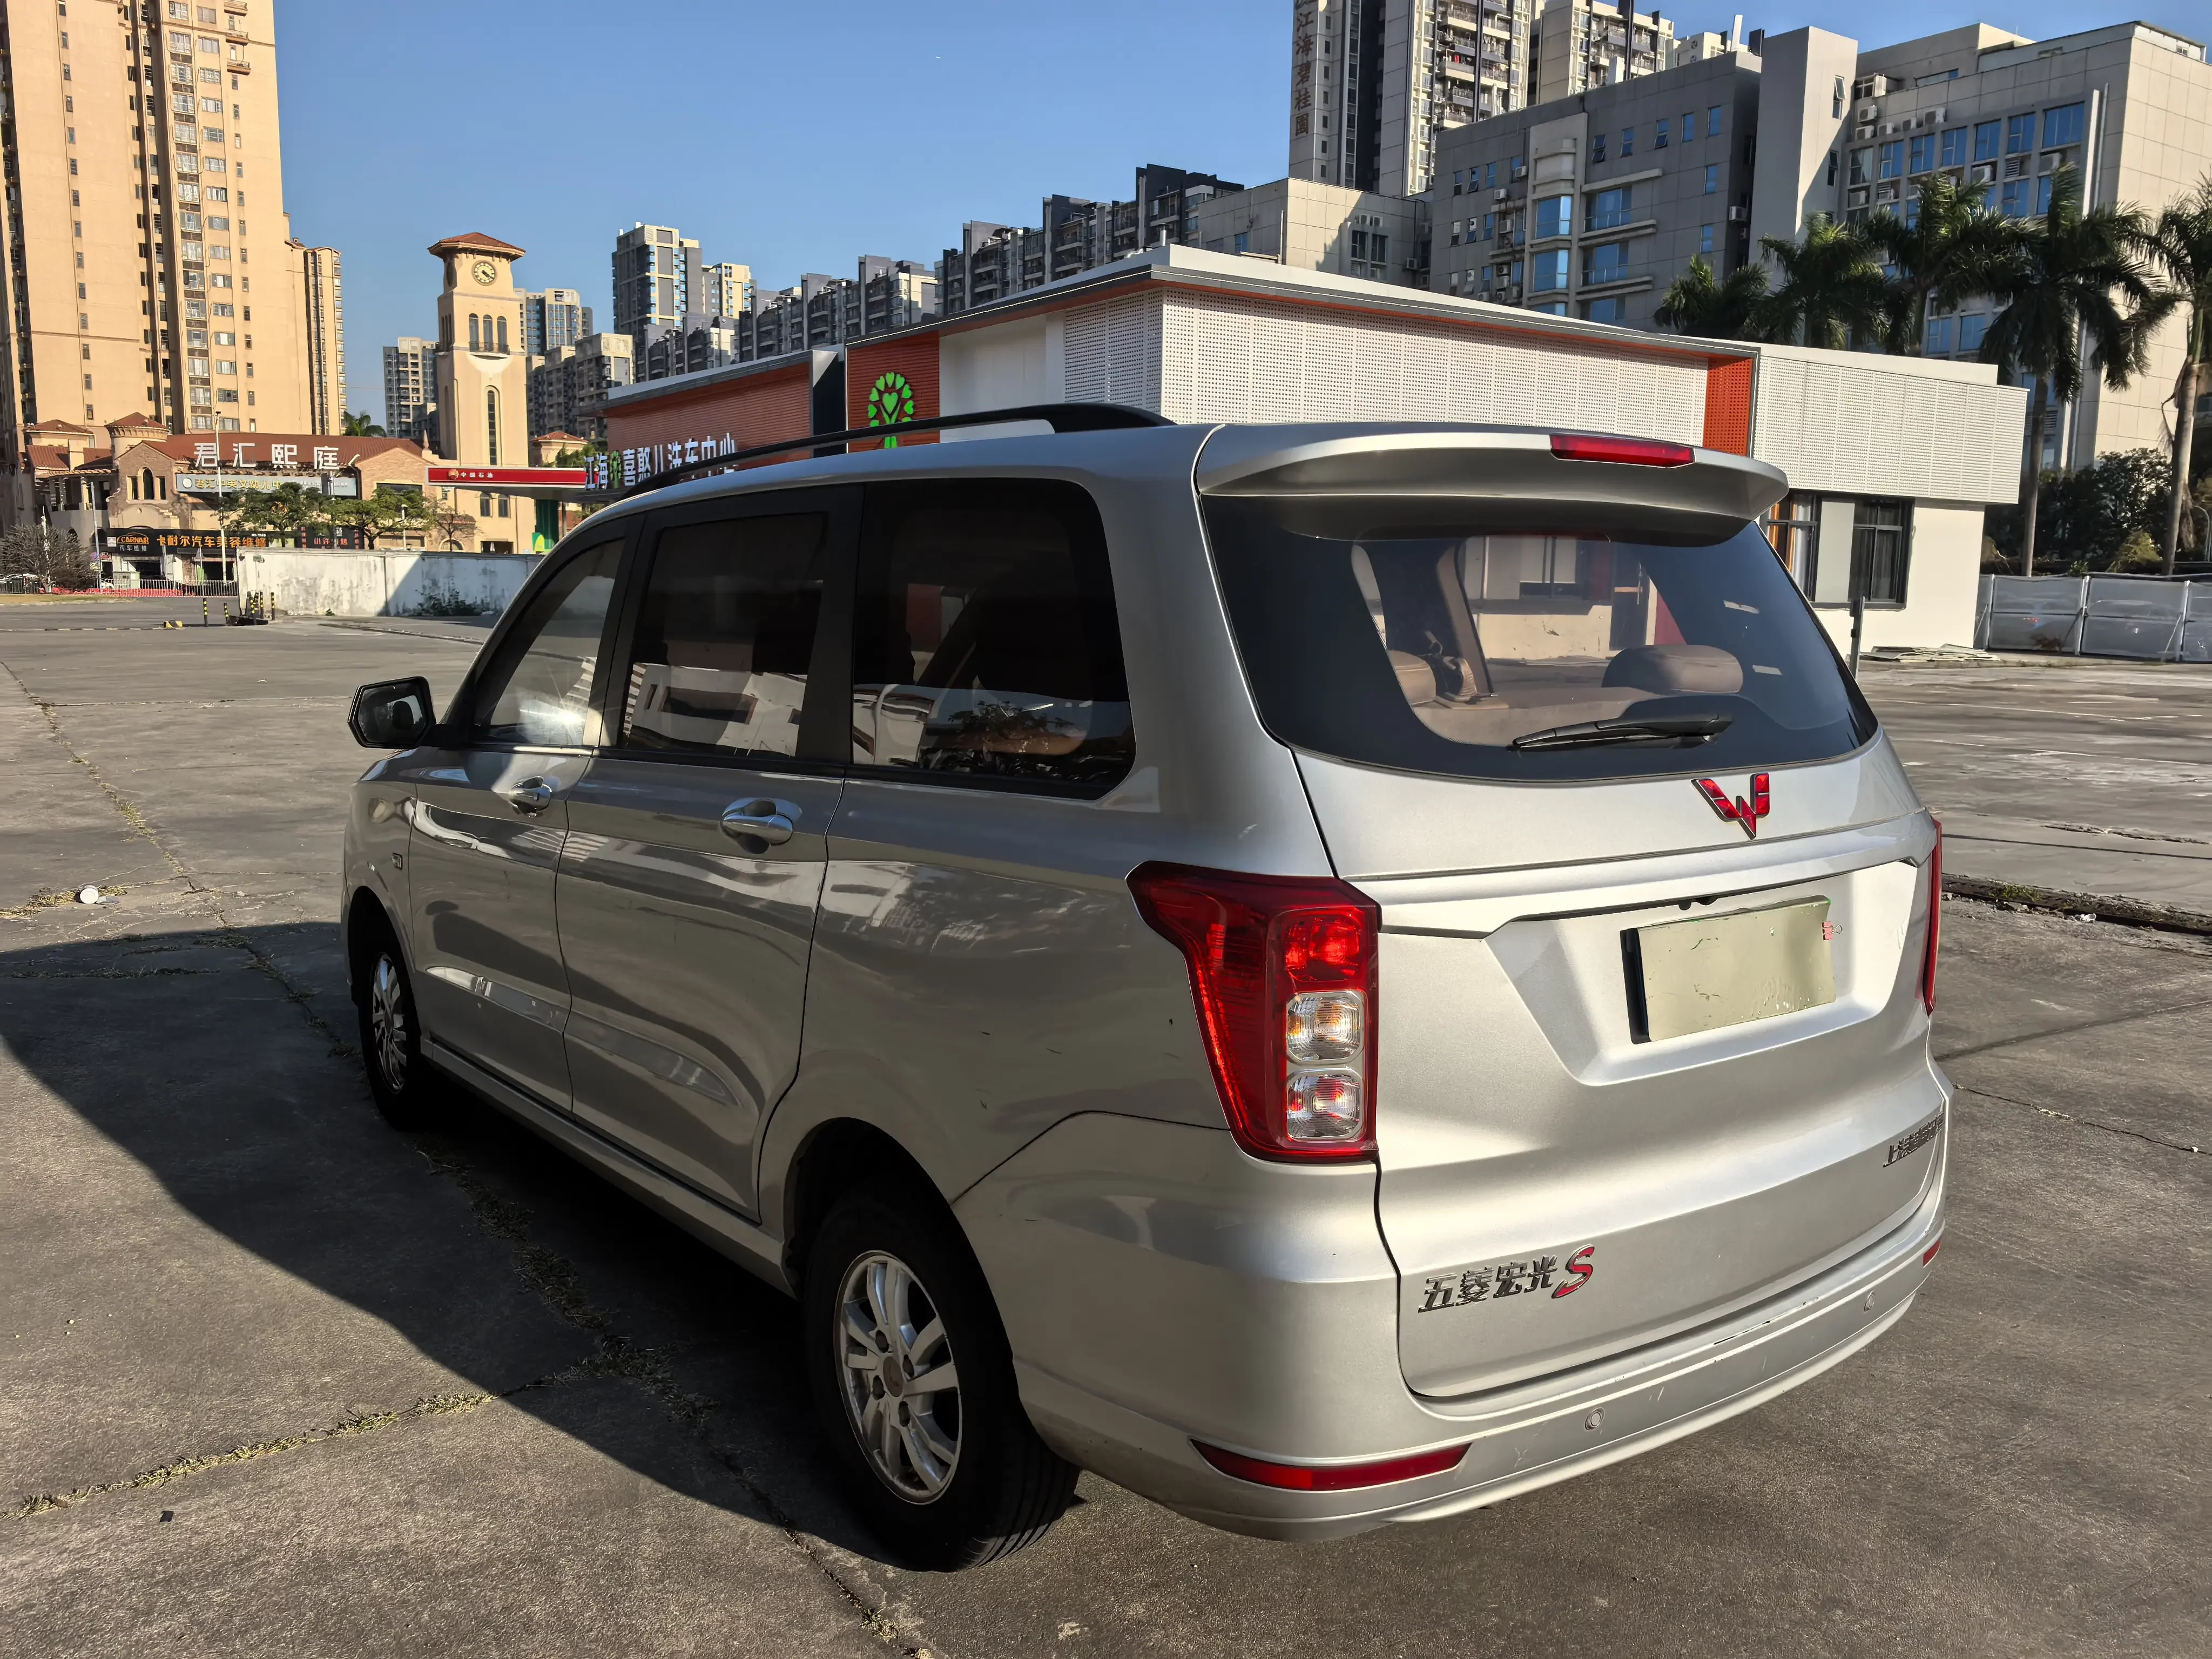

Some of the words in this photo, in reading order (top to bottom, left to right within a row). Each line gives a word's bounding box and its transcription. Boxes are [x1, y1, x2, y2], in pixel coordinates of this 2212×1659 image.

[194, 442, 340, 470] 君汇熙庭
[157, 534, 266, 548] 卡耐尔汽车美容维修
